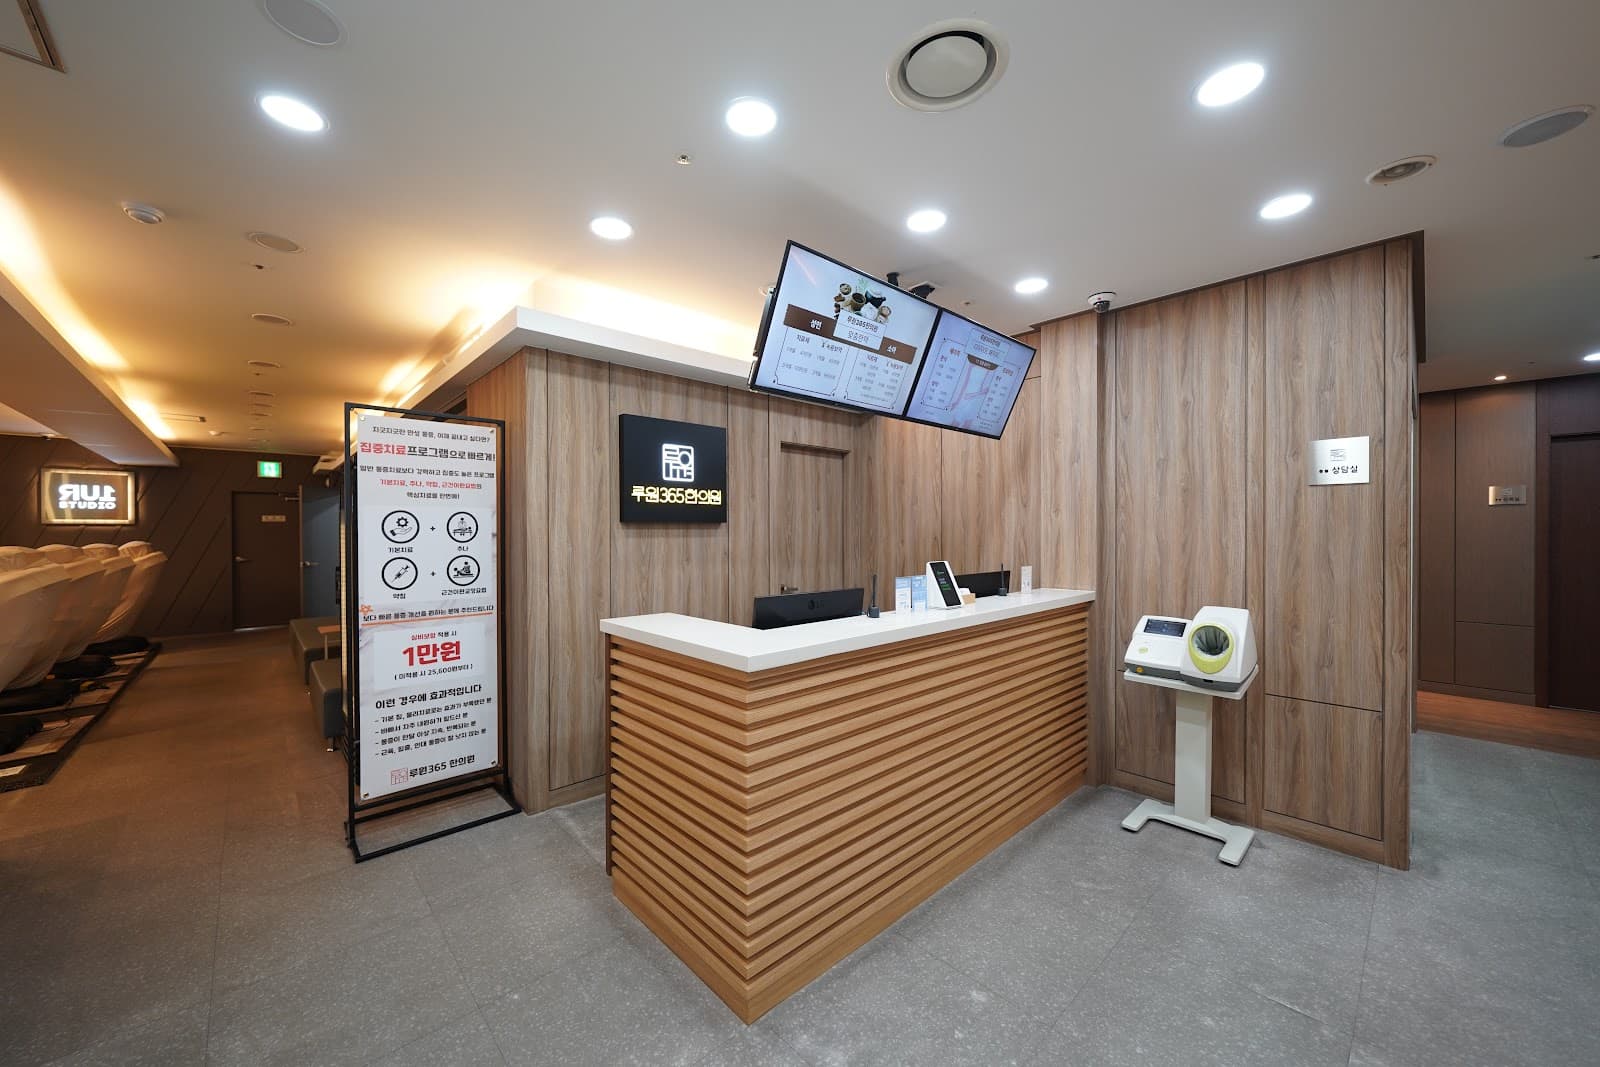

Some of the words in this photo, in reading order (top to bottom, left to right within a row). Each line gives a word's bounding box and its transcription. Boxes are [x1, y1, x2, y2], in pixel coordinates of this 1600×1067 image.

[372, 426, 406, 436] 지긋지긋한
[407, 429, 420, 437] 만성
[422, 431, 436, 439] 통증,
[451, 433, 468, 441] 끝내고
[470, 435, 490, 443] 싶다면?
[416, 468, 441, 476] 강력하고
[442, 469, 460, 477] 집중도
[473, 471, 495, 479] 프로그램
[1332, 464, 1358, 475] 상담실
[631, 485, 722, 505] 루원365한의원
[461, 604, 494, 613] 추천드립니다
[402, 640, 461, 666] 1만원
[375, 698, 396, 709] 이런
[398, 692, 427, 706] 경우에
[429, 684, 482, 701] 효과적입니다
[380, 715, 394, 723] 기본
[444, 703, 462, 712] 효과가
[380, 725, 401, 735] 바빠서
[402, 722, 416, 730] 자주
[381, 736, 400, 746] 통증이
[416, 730, 430, 738] 이상
[409, 761, 447, 778] 루원365
[449, 754, 475, 768] 한의원
